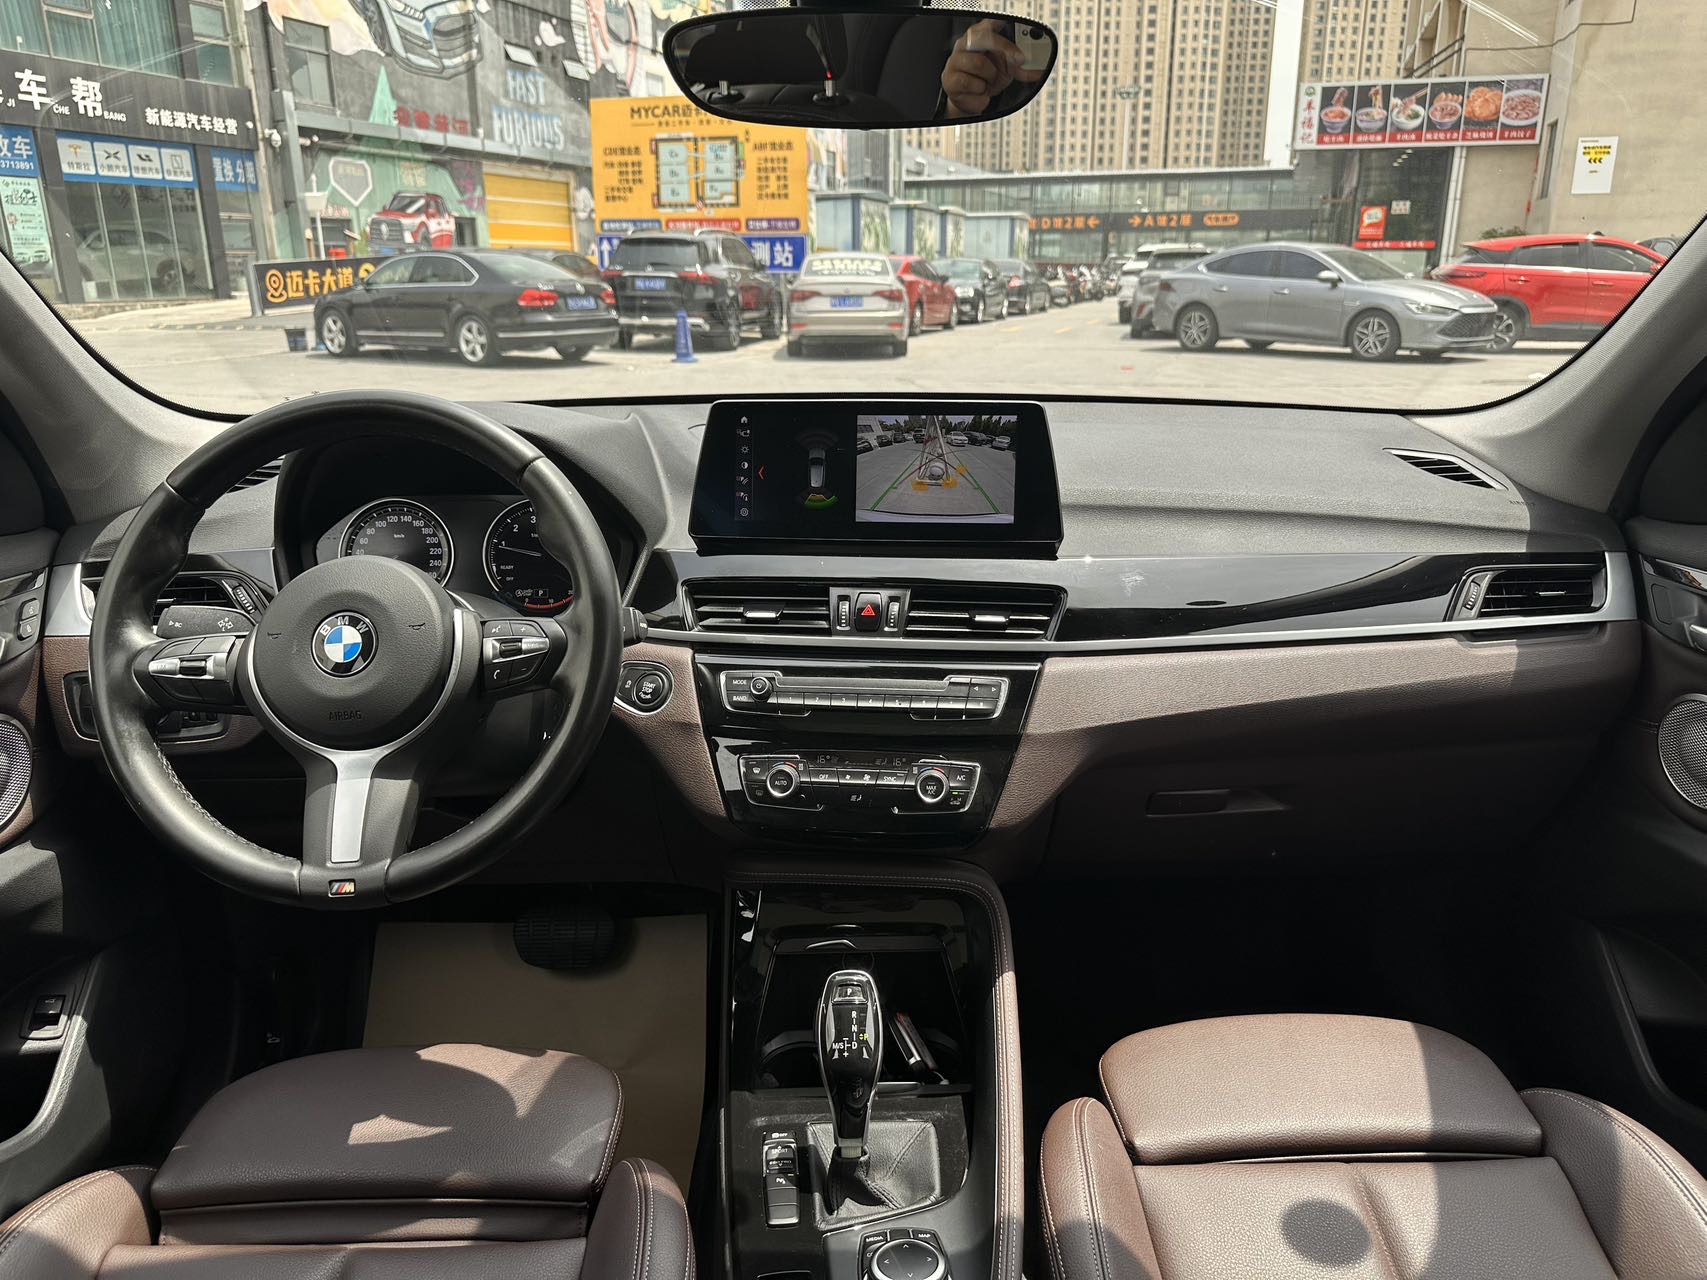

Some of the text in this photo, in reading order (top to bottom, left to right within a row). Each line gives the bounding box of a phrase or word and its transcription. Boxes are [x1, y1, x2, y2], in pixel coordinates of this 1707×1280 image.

[506, 69, 545, 106] FAST
[14, 68, 103, 117] 车 帮
[53, 104, 70, 115] CHE
[145, 107, 238, 135] 新能源汽车经营
[286, 266, 353, 298] 迈卡大道
[387, 515, 398, 523] 120
[400, 515, 412, 523] 140
[530, 515, 537, 524] 3
[512, 524, 519, 533] 2
[359, 537, 368, 545] 60
[426, 536, 439, 544] 200
[429, 548, 442, 556] 220
[319, 615, 369, 636] BMW
[329, 711, 362, 721] AIRBAG
